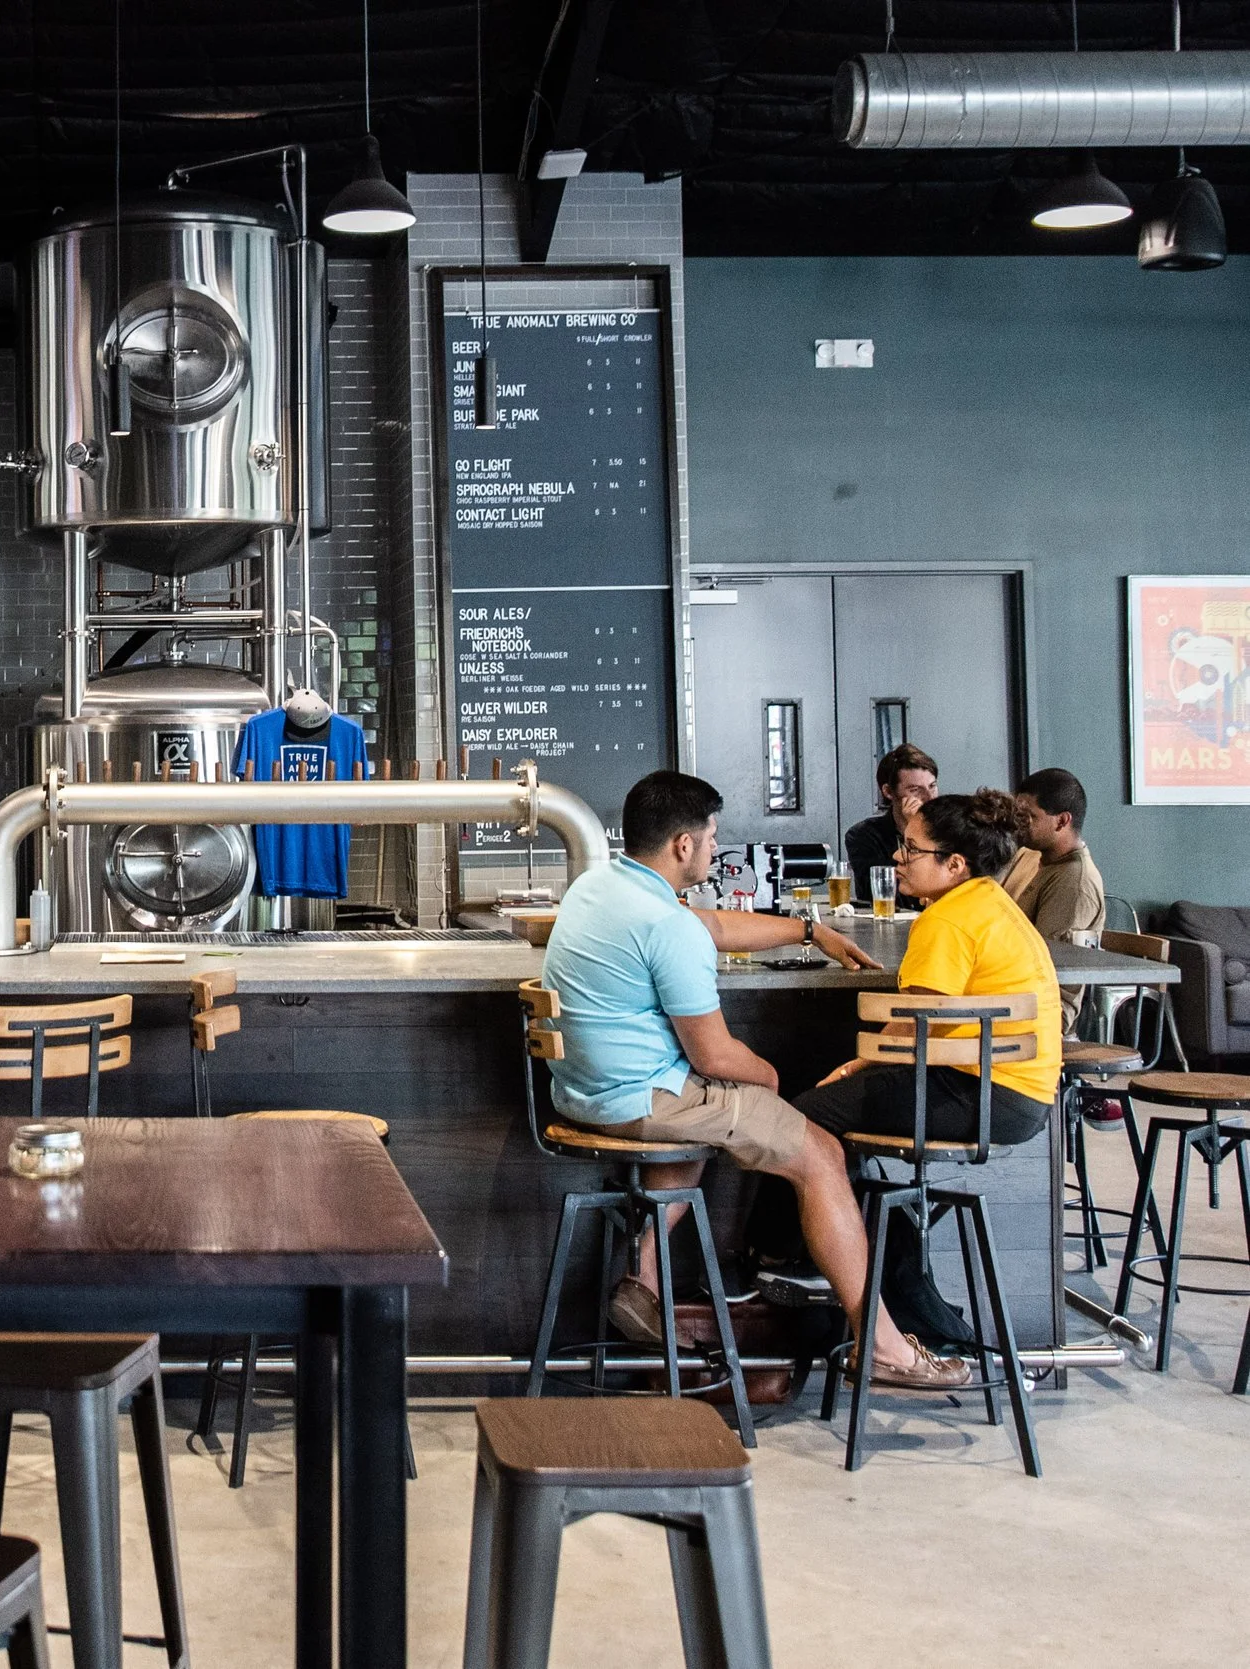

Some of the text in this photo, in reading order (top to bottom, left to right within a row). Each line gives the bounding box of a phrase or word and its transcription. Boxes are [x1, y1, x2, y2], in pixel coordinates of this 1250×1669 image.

[471, 313, 636, 329] TRUE ANOMALY BREWING CO
[453, 385, 476, 398] SMA
[511, 408, 540, 421] PARK
[455, 458, 512, 472] GO FLIGHT
[456, 472, 469, 480] NEW
[456, 481, 575, 496] SPIROGRAPH NEBULA
[455, 507, 545, 521] CONTACT LIGHT
[457, 521, 481, 529] MOSAIC
[483, 521, 494, 529] DRY
[495, 521, 518, 529] HOPPED
[459, 607, 532, 621] SOUR ALES/
[460, 625, 524, 640] FRIEDRICH'S
[472, 639, 532, 653] NOTEBOOK
[529, 651, 568, 659] CORIANDER
[461, 674, 524, 683] BERLINER WEISSE
[505, 685, 519, 693] OAK
[522, 685, 546, 693] FOEDER
[550, 684, 566, 692] AGED
[571, 684, 589, 692] WILD
[461, 701, 548, 715] OLIVER WILDER
[473, 715, 496, 723] SAISON
[462, 727, 558, 742] DAISY EXPLORER
[487, 743, 502, 751] WILD
[506, 742, 519, 750] ALE
[530, 742, 549, 750] DAISY
[553, 741, 575, 749] CHAIN
[536, 748, 566, 757] PROJECT
[288, 753, 318, 762] TRUE
[1152, 748, 1232, 770] MARS
